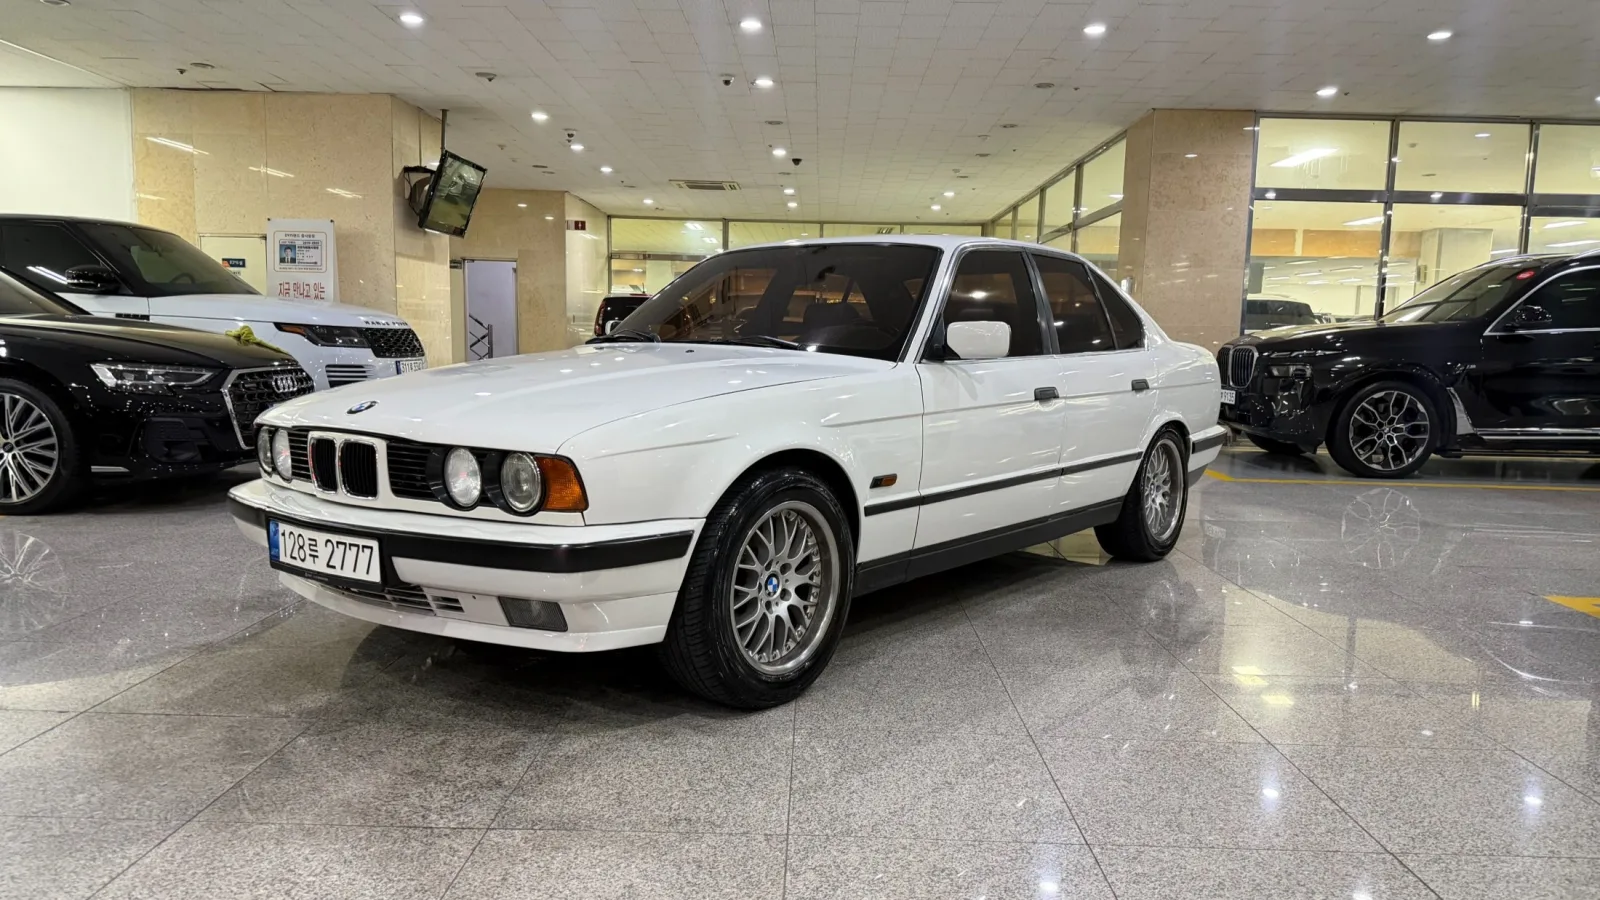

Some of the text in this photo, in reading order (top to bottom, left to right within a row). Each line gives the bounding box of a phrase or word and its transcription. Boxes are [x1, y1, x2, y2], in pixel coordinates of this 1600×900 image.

[278, 281, 326, 300] 지금 만나고 있는
[281, 529, 374, 575] 128루 2777
